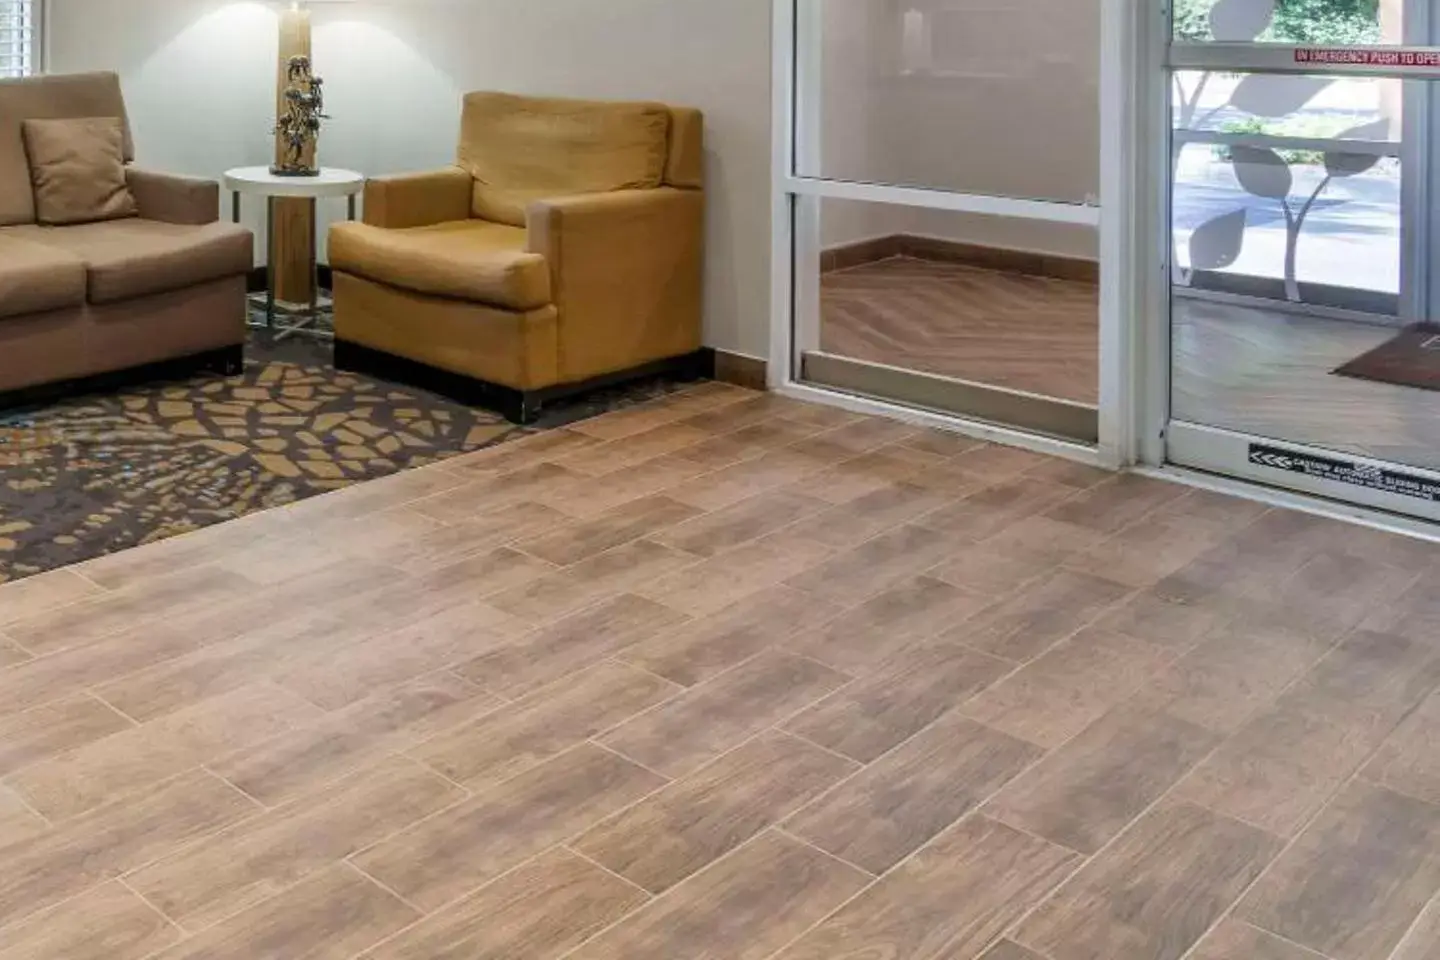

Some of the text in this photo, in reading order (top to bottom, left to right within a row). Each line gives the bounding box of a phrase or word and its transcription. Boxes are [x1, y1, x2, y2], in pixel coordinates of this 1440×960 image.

[1296, 49, 1440, 65] IN EMERGENCY PUSH TO OPE
